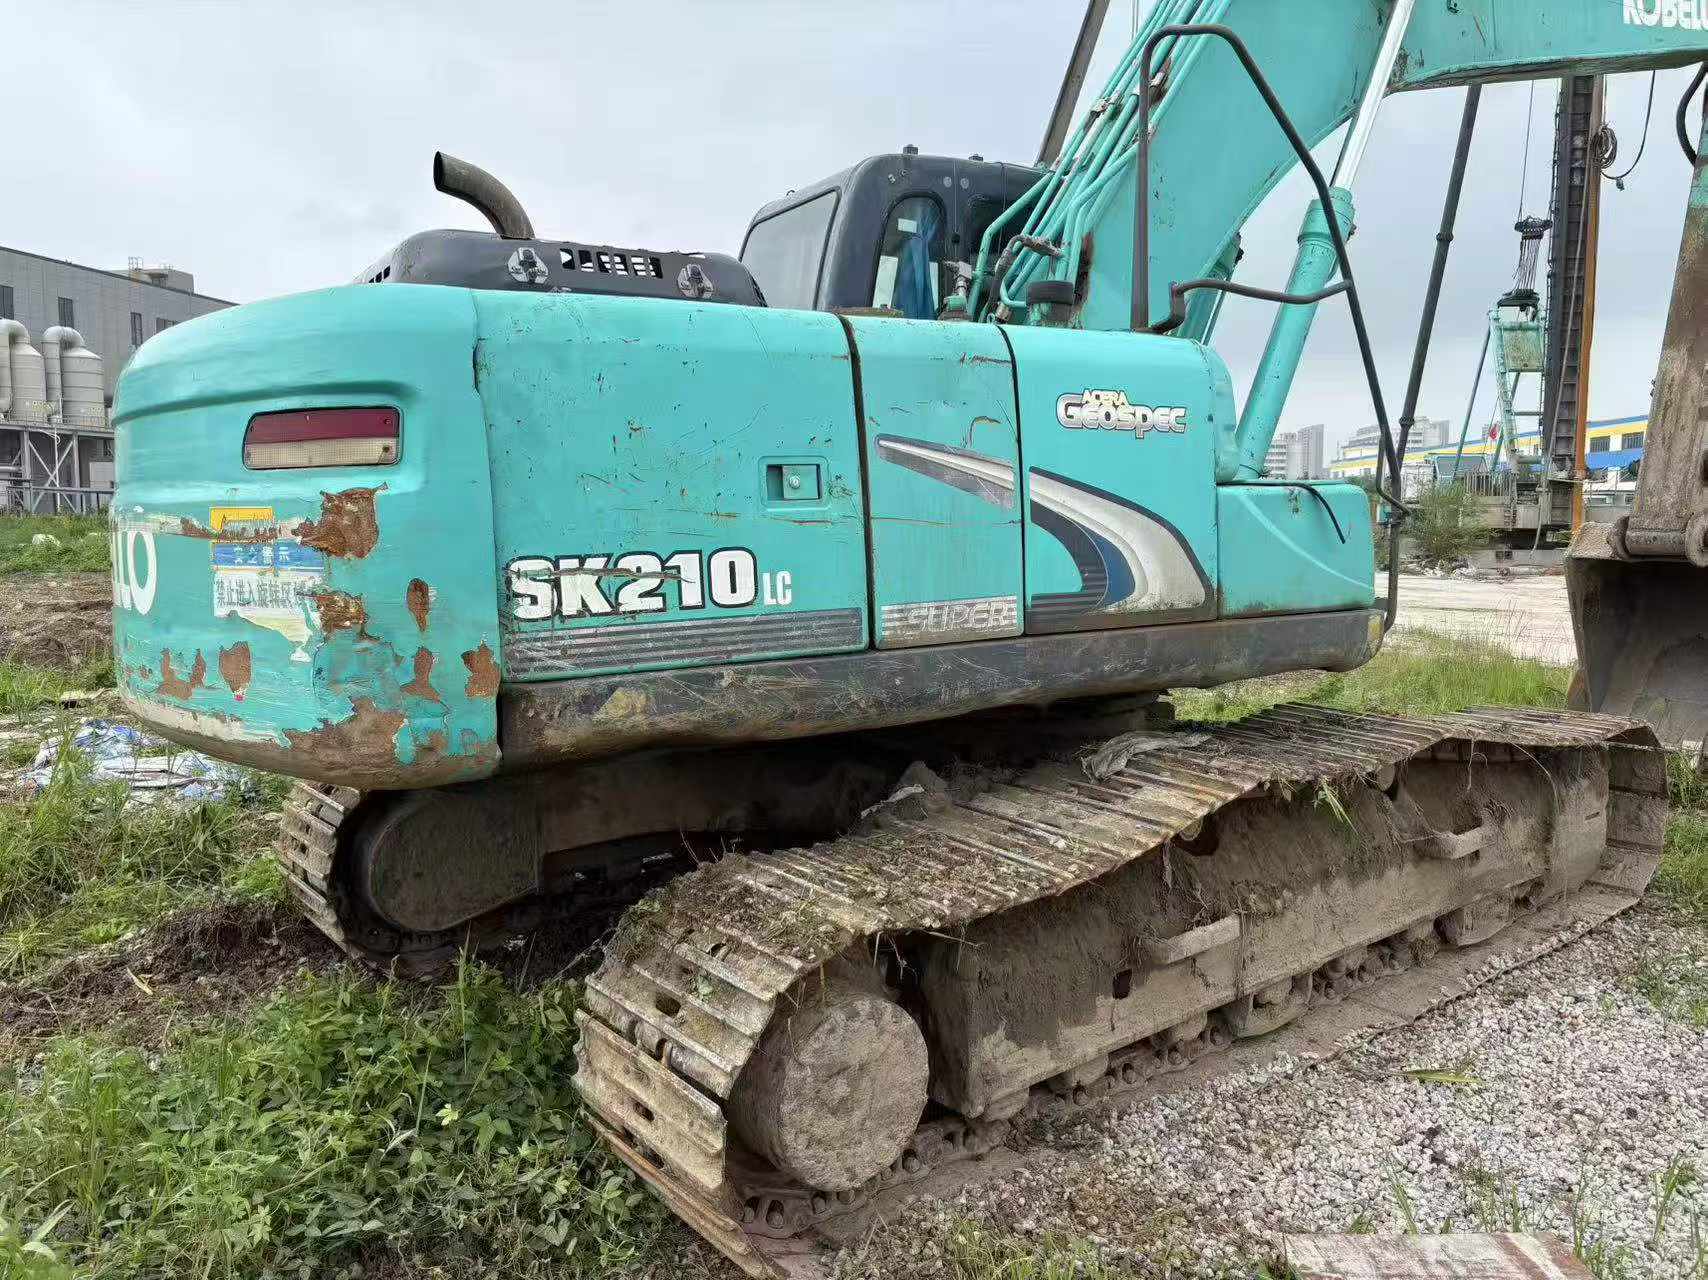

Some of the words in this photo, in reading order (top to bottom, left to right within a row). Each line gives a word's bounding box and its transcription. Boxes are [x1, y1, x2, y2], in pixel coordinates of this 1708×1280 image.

[1623, 0, 1708, 31] KOBEL
[505, 547, 758, 622] SK210
[763, 570, 792, 606] LC
